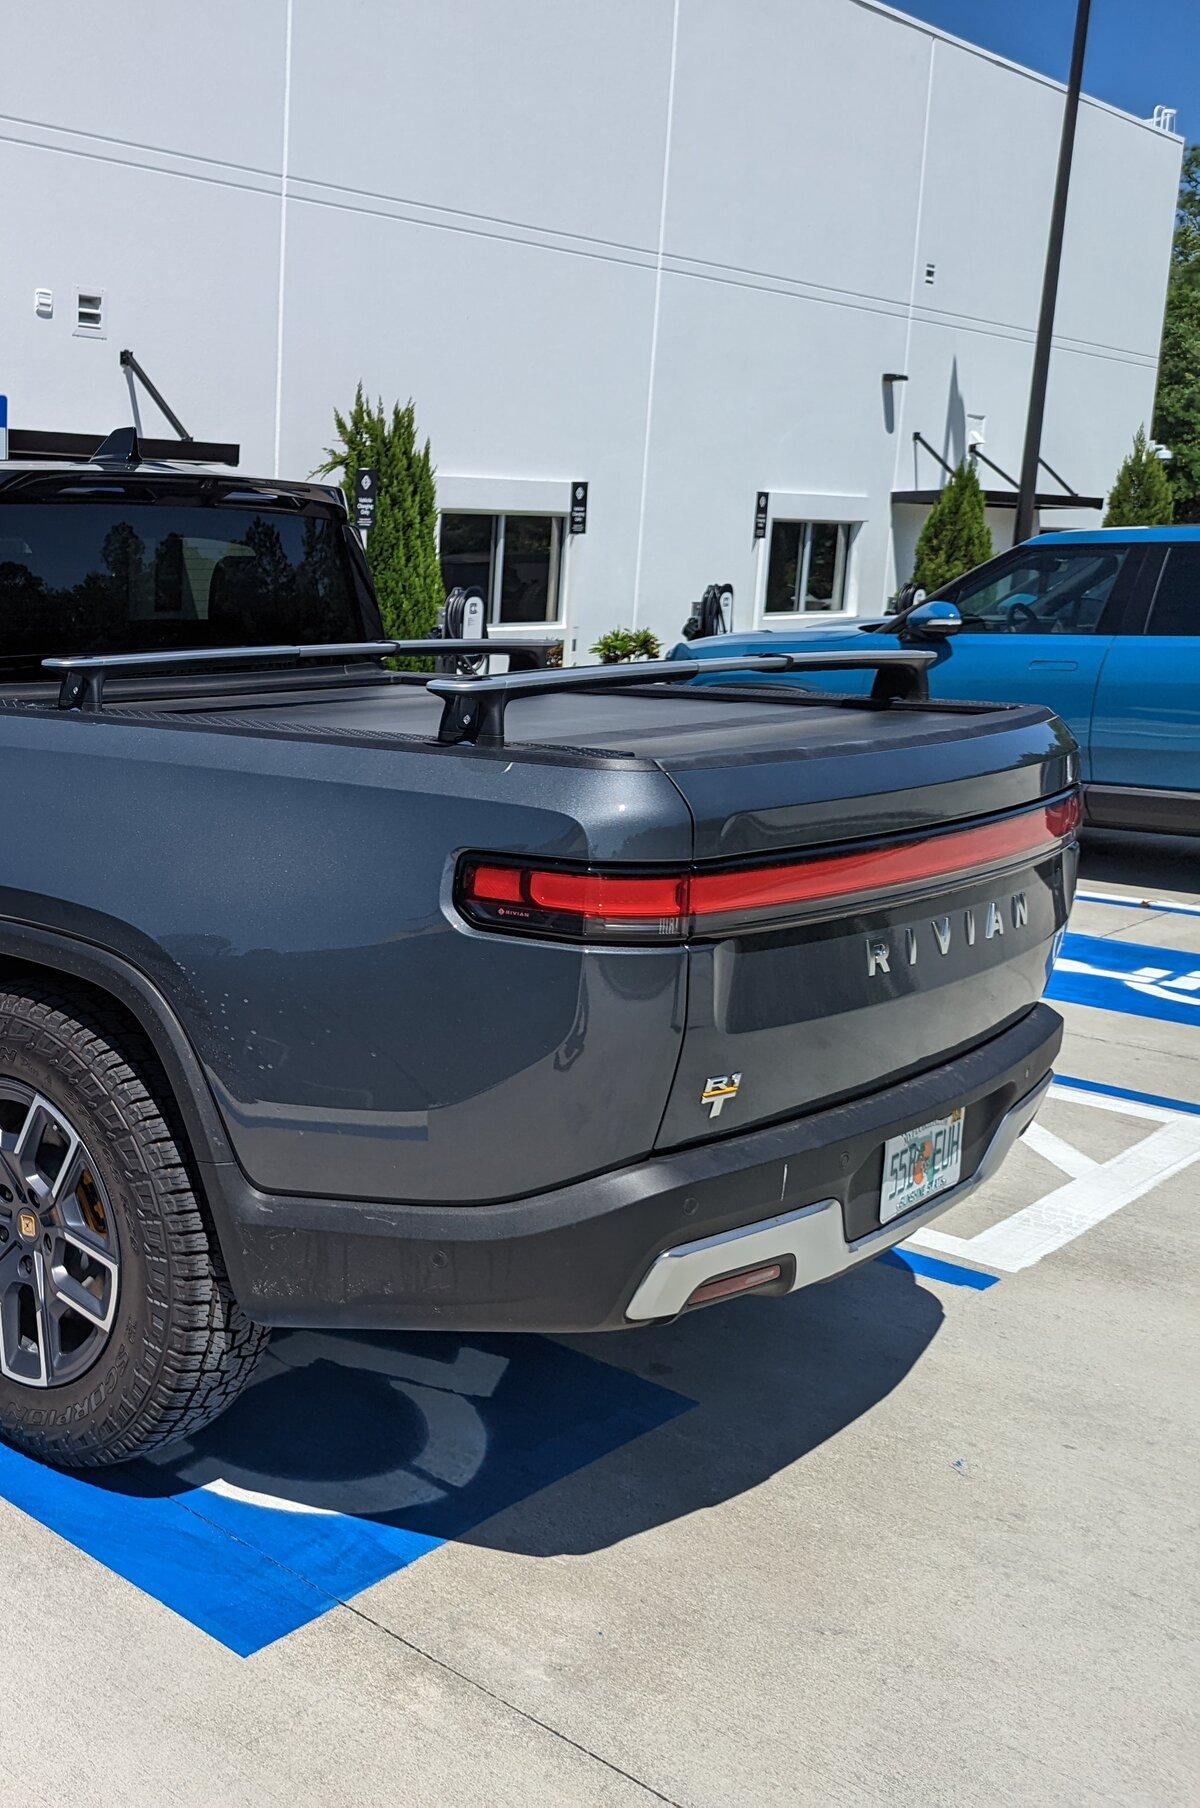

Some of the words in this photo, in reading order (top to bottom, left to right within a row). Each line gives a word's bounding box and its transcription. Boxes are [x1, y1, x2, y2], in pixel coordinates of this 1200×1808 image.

[505, 909, 530, 918] RIVIAN
[865, 891, 1029, 977] RIVIAN
[932, 1122, 961, 1173] EUH
[4, 1344, 129, 1427] SCORPION
